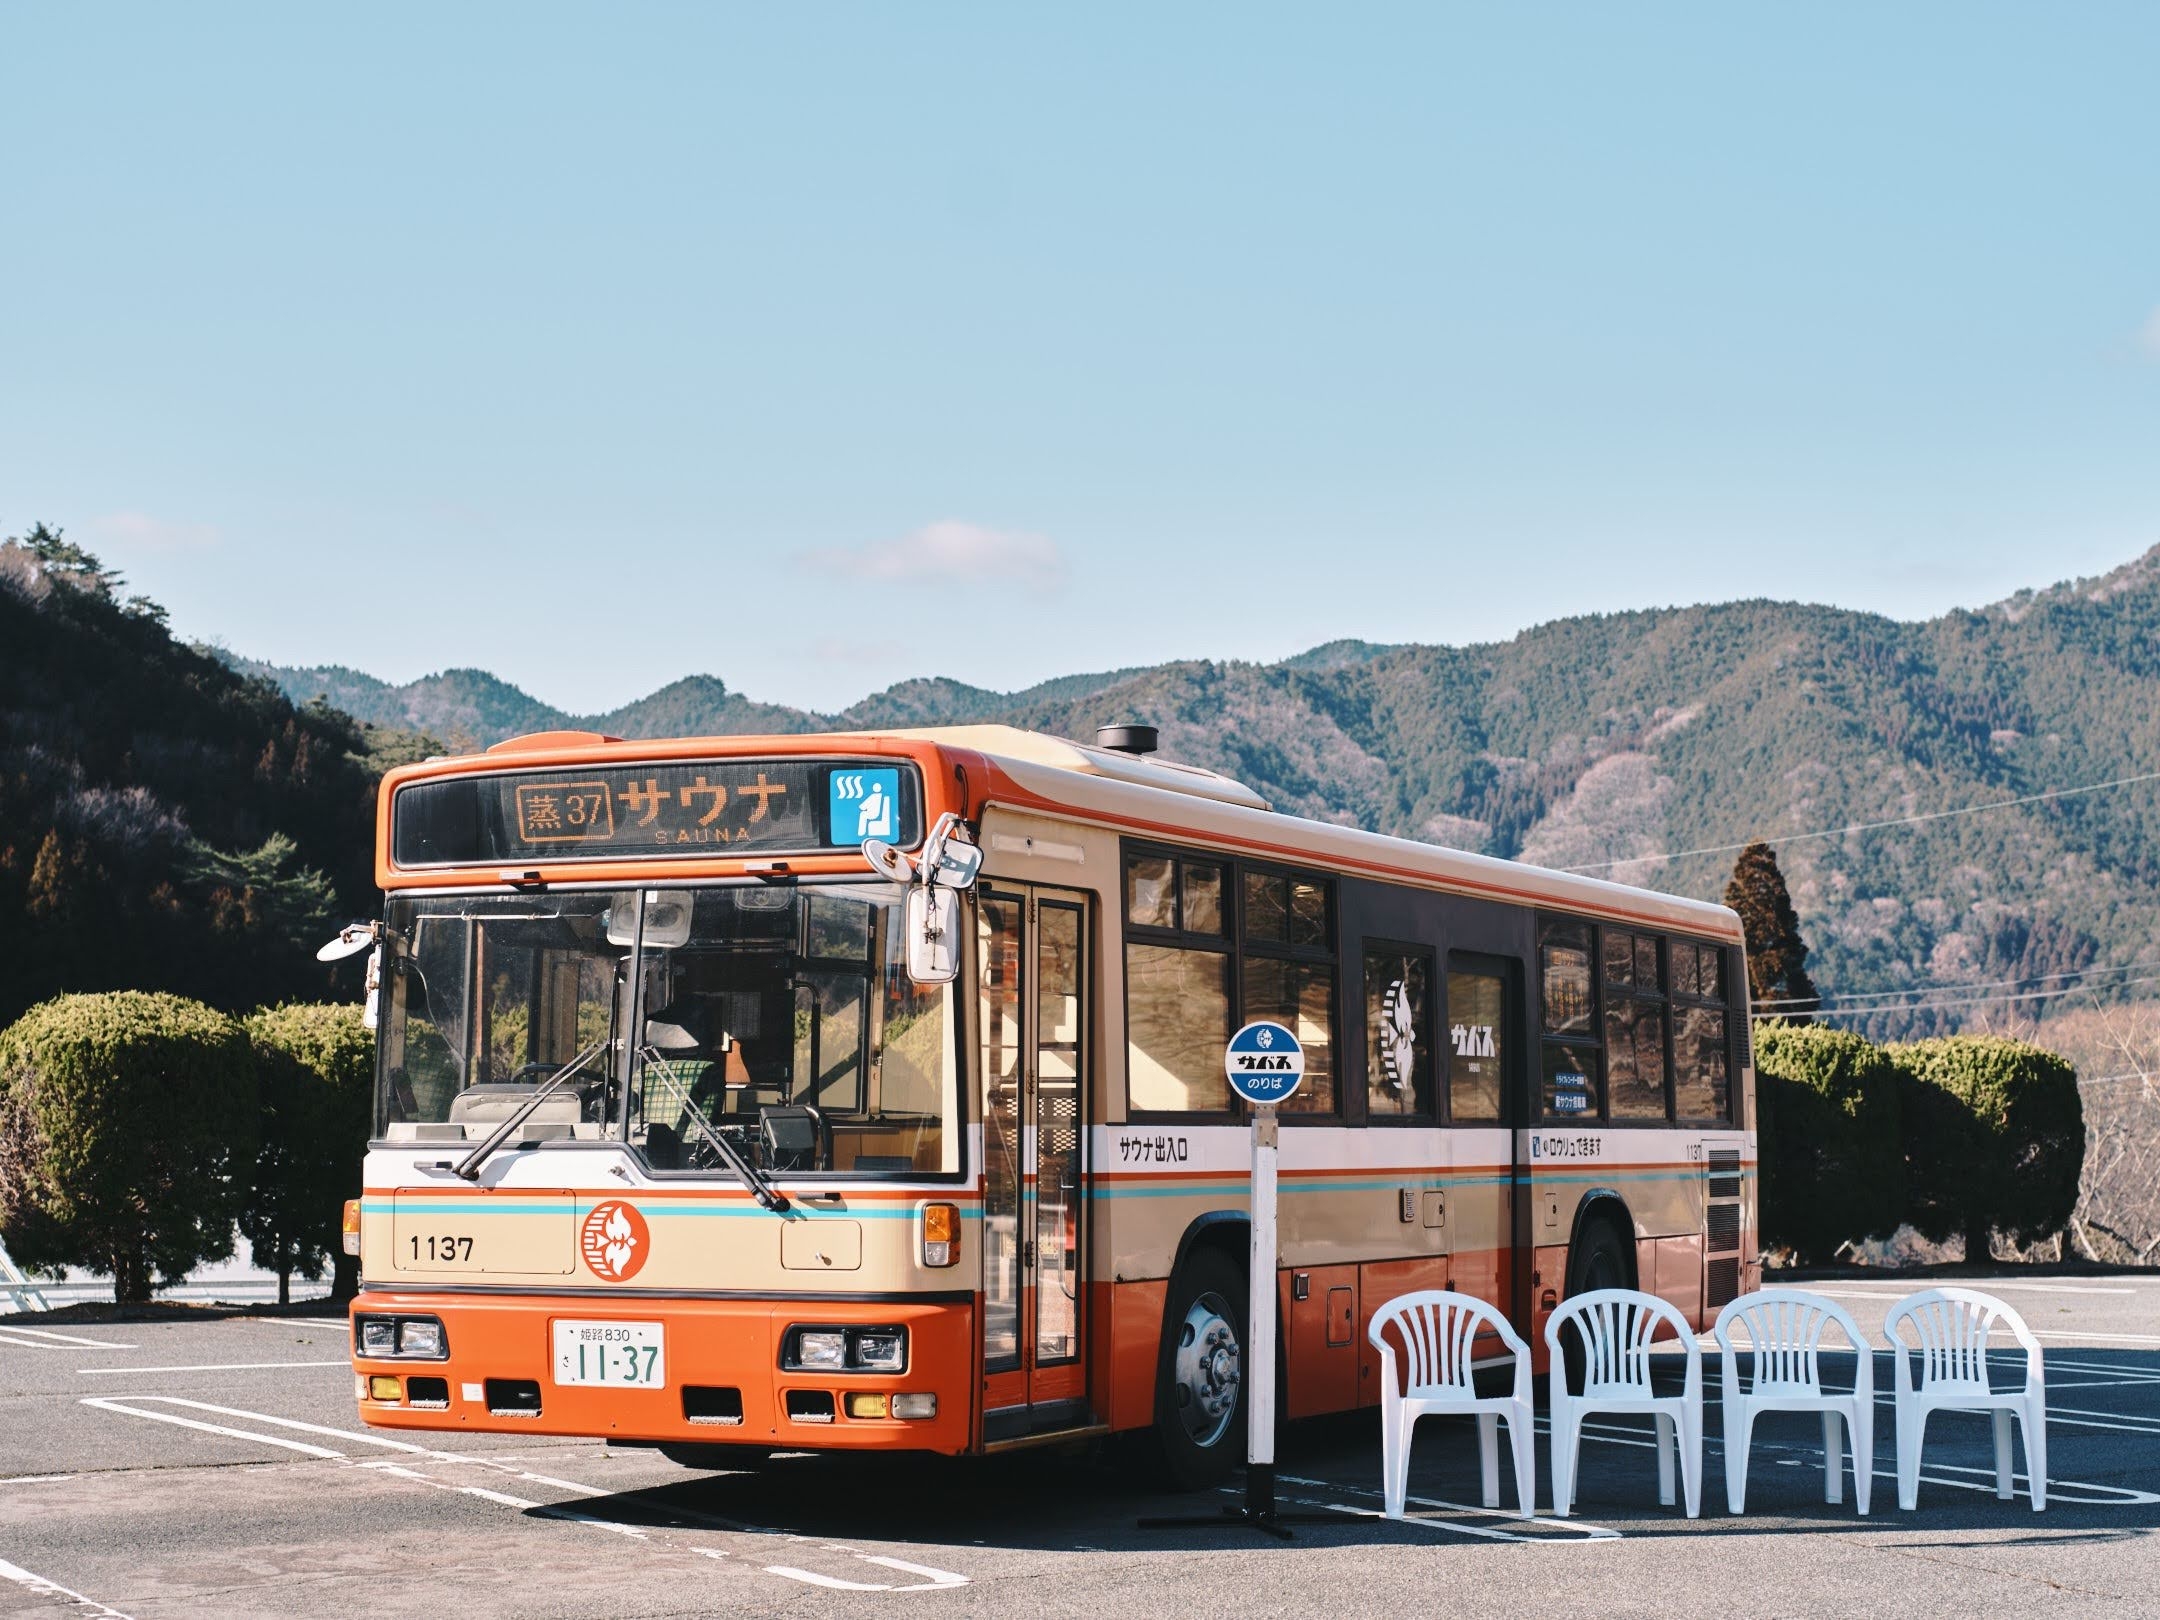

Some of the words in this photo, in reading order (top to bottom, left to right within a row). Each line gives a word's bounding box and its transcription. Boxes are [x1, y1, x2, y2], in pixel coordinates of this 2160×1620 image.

[618, 773, 787, 827] サウナ
[655, 827, 751, 844] SAUNA
[1451, 1024, 1495, 1057] サバス
[1237, 1055, 1292, 1070] サバス
[1247, 1077, 1283, 1090] のりば
[1120, 1136, 1188, 1162] サウナ出入口
[1549, 1136, 1602, 1157] ロウリュできます
[410, 1236, 473, 1261] 1137
[580, 1344, 658, 1382] 11-37
